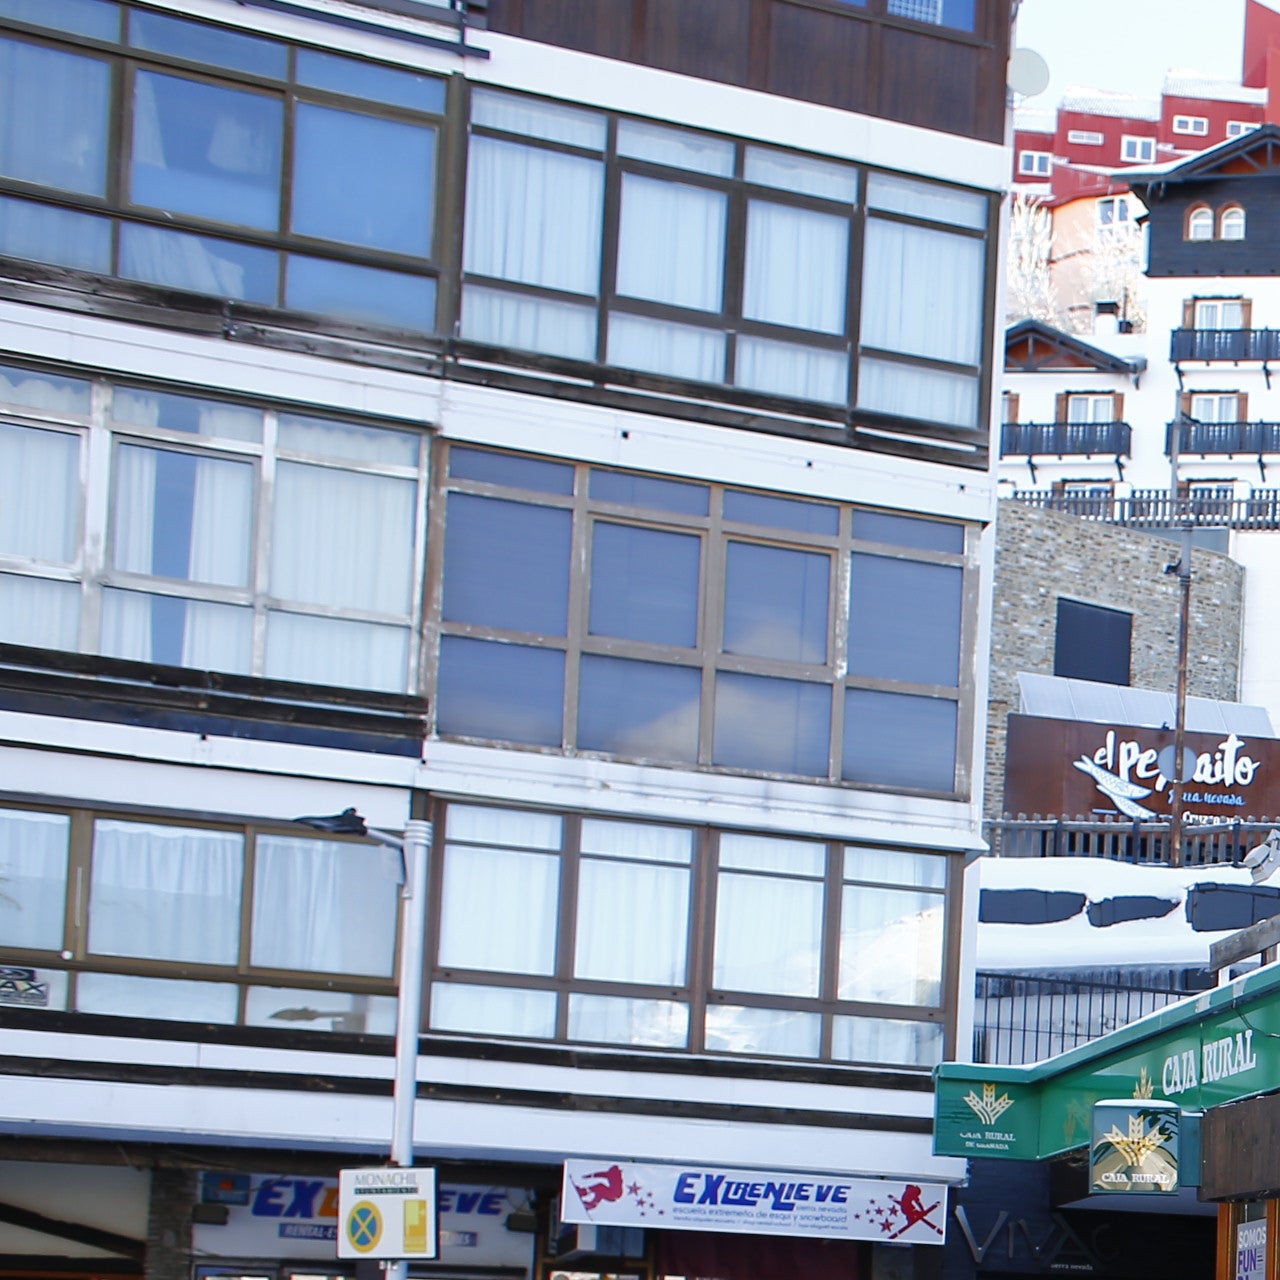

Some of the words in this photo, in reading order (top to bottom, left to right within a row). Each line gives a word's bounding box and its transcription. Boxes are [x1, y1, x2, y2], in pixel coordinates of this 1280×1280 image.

[1093, 729, 1116, 770] el
[1162, 1049, 1198, 1096] CAJA
[1201, 1028, 1257, 1085] RURAL
[985, 1131, 1017, 1142] RURAL
[353, 1172, 418, 1186] MONACHIL
[1131, 1173, 1171, 1185] RURAL
[755, 1208, 769, 1218] de
[799, 1212, 849, 1223] snowboard
[1238, 1226, 1267, 1249] SOMOS
[1237, 1248, 1258, 1275] FUN
